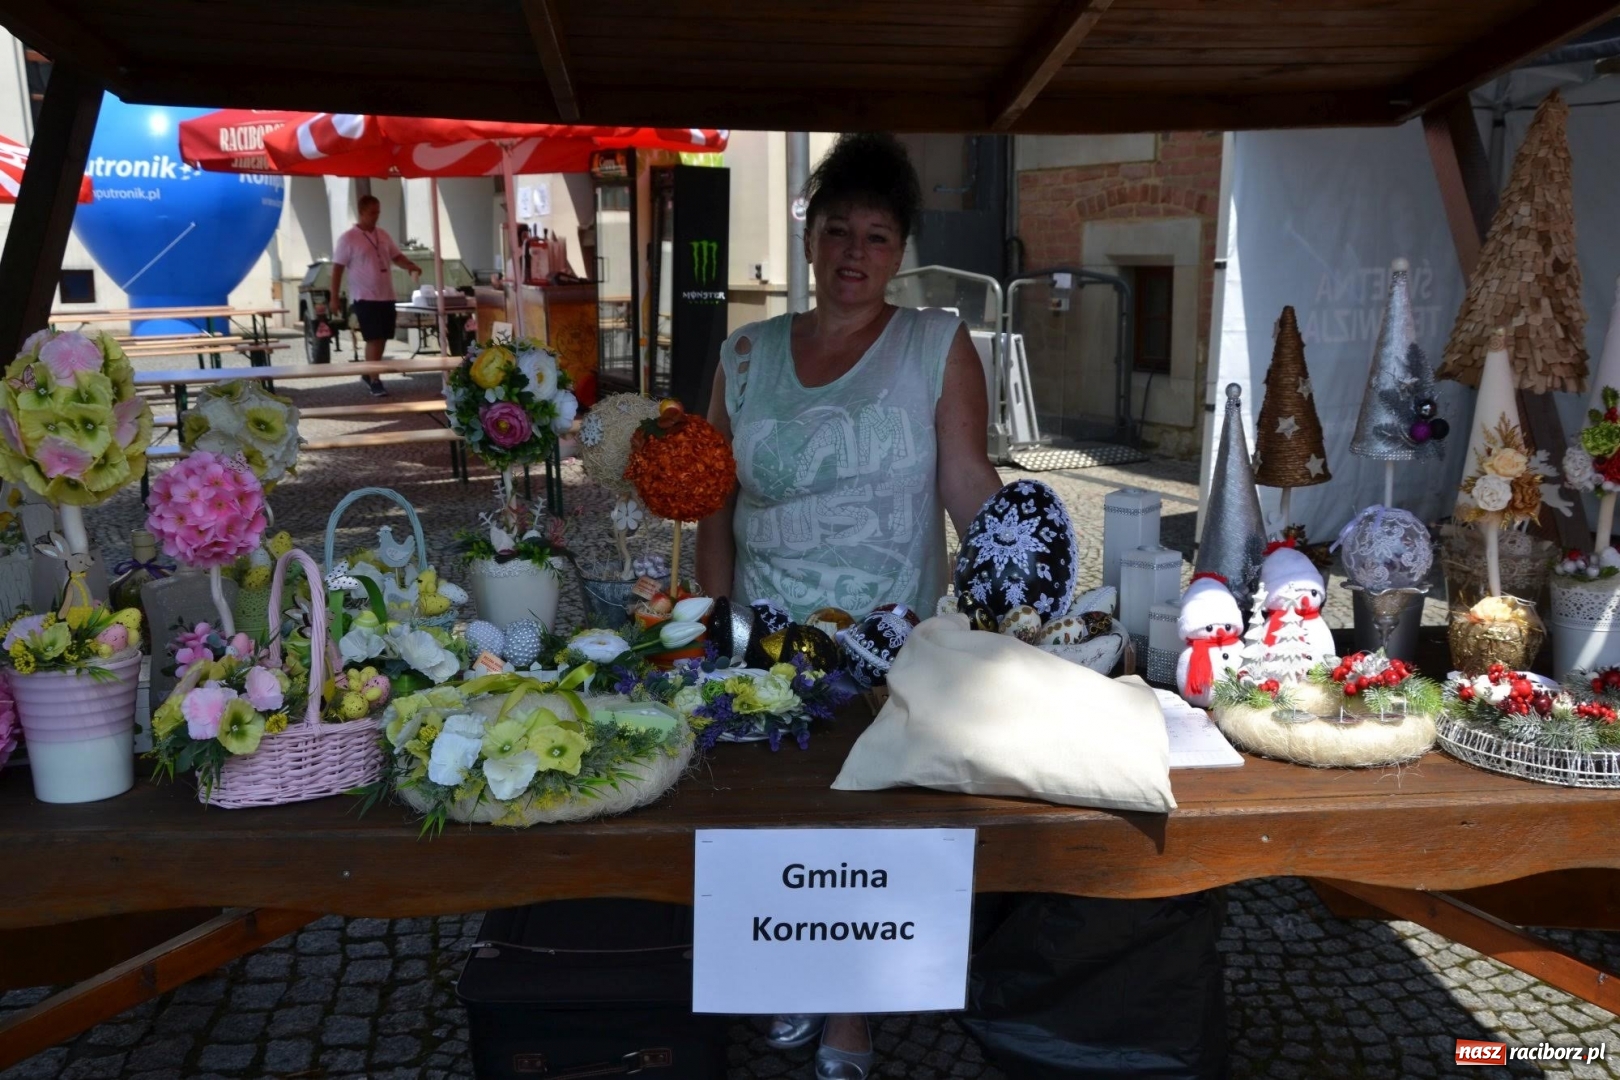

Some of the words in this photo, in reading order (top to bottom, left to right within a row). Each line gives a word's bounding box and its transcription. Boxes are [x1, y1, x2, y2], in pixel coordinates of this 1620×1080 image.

[682, 290, 726, 300] MONSTER
[782, 862, 888, 889] Gmina
[753, 916, 915, 941] Kornowac
